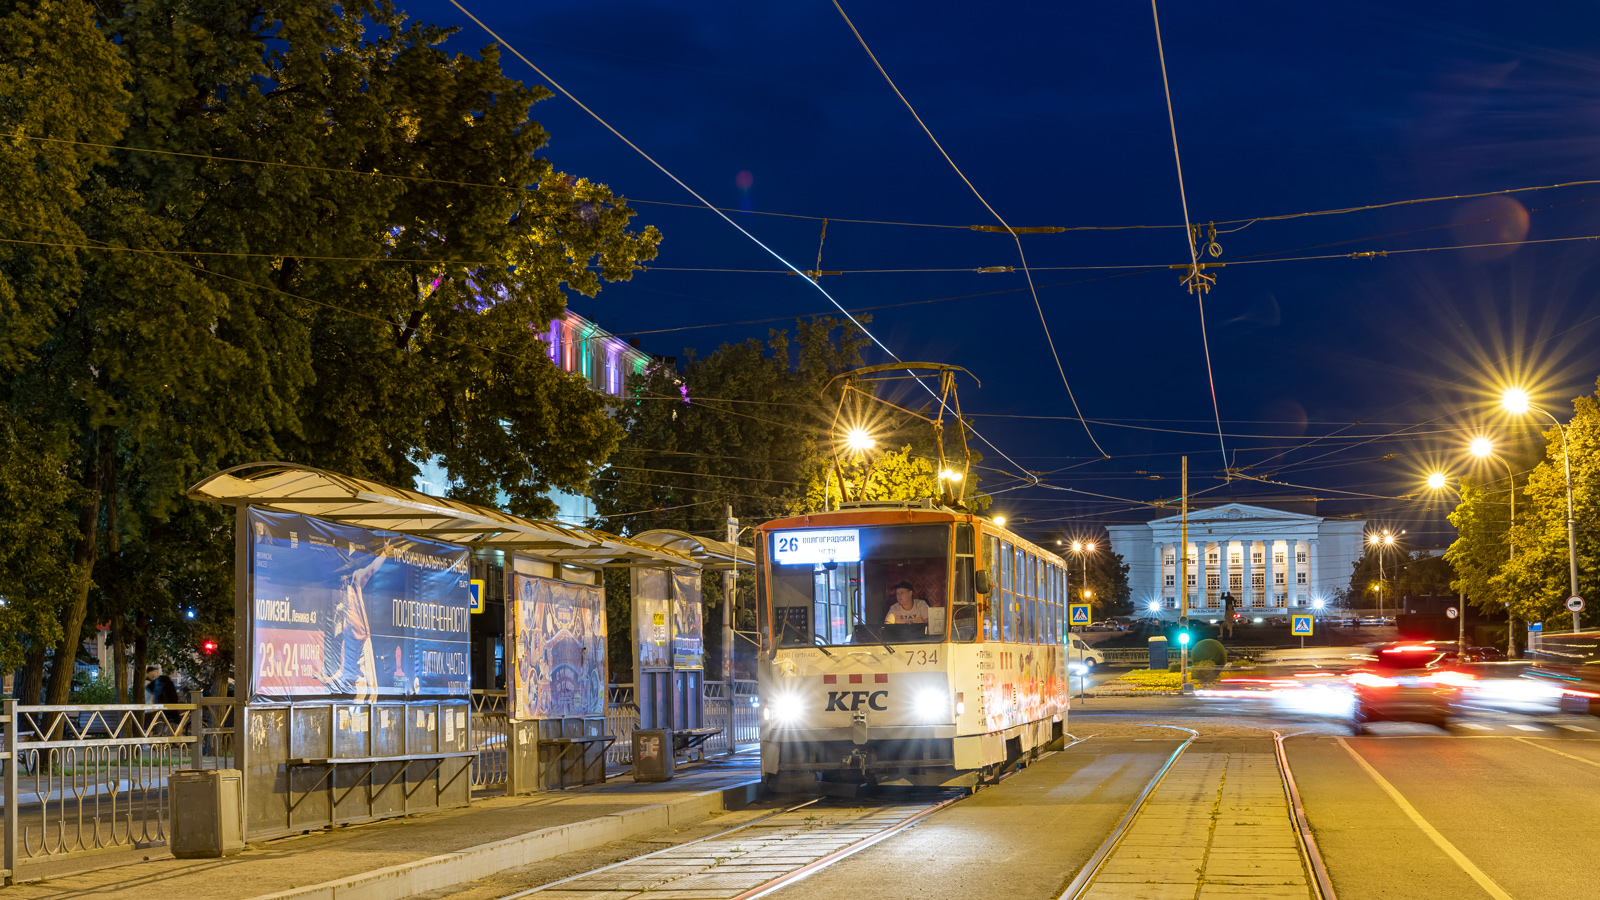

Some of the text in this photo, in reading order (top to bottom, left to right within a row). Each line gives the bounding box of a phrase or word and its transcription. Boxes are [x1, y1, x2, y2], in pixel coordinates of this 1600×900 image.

[779, 537, 799, 553] 26
[393, 548, 448, 571] ПРОВИНЦИАЛЬНЫЕ
[256, 596, 317, 625] КОЛИЗЕЙ, Ленина 43
[259, 642, 274, 678] 23
[283, 642, 299, 678] 24
[446, 651, 465, 675] ЧАСТЬ
[905, 649, 938, 667] 734
[825, 690, 889, 712] KFC
